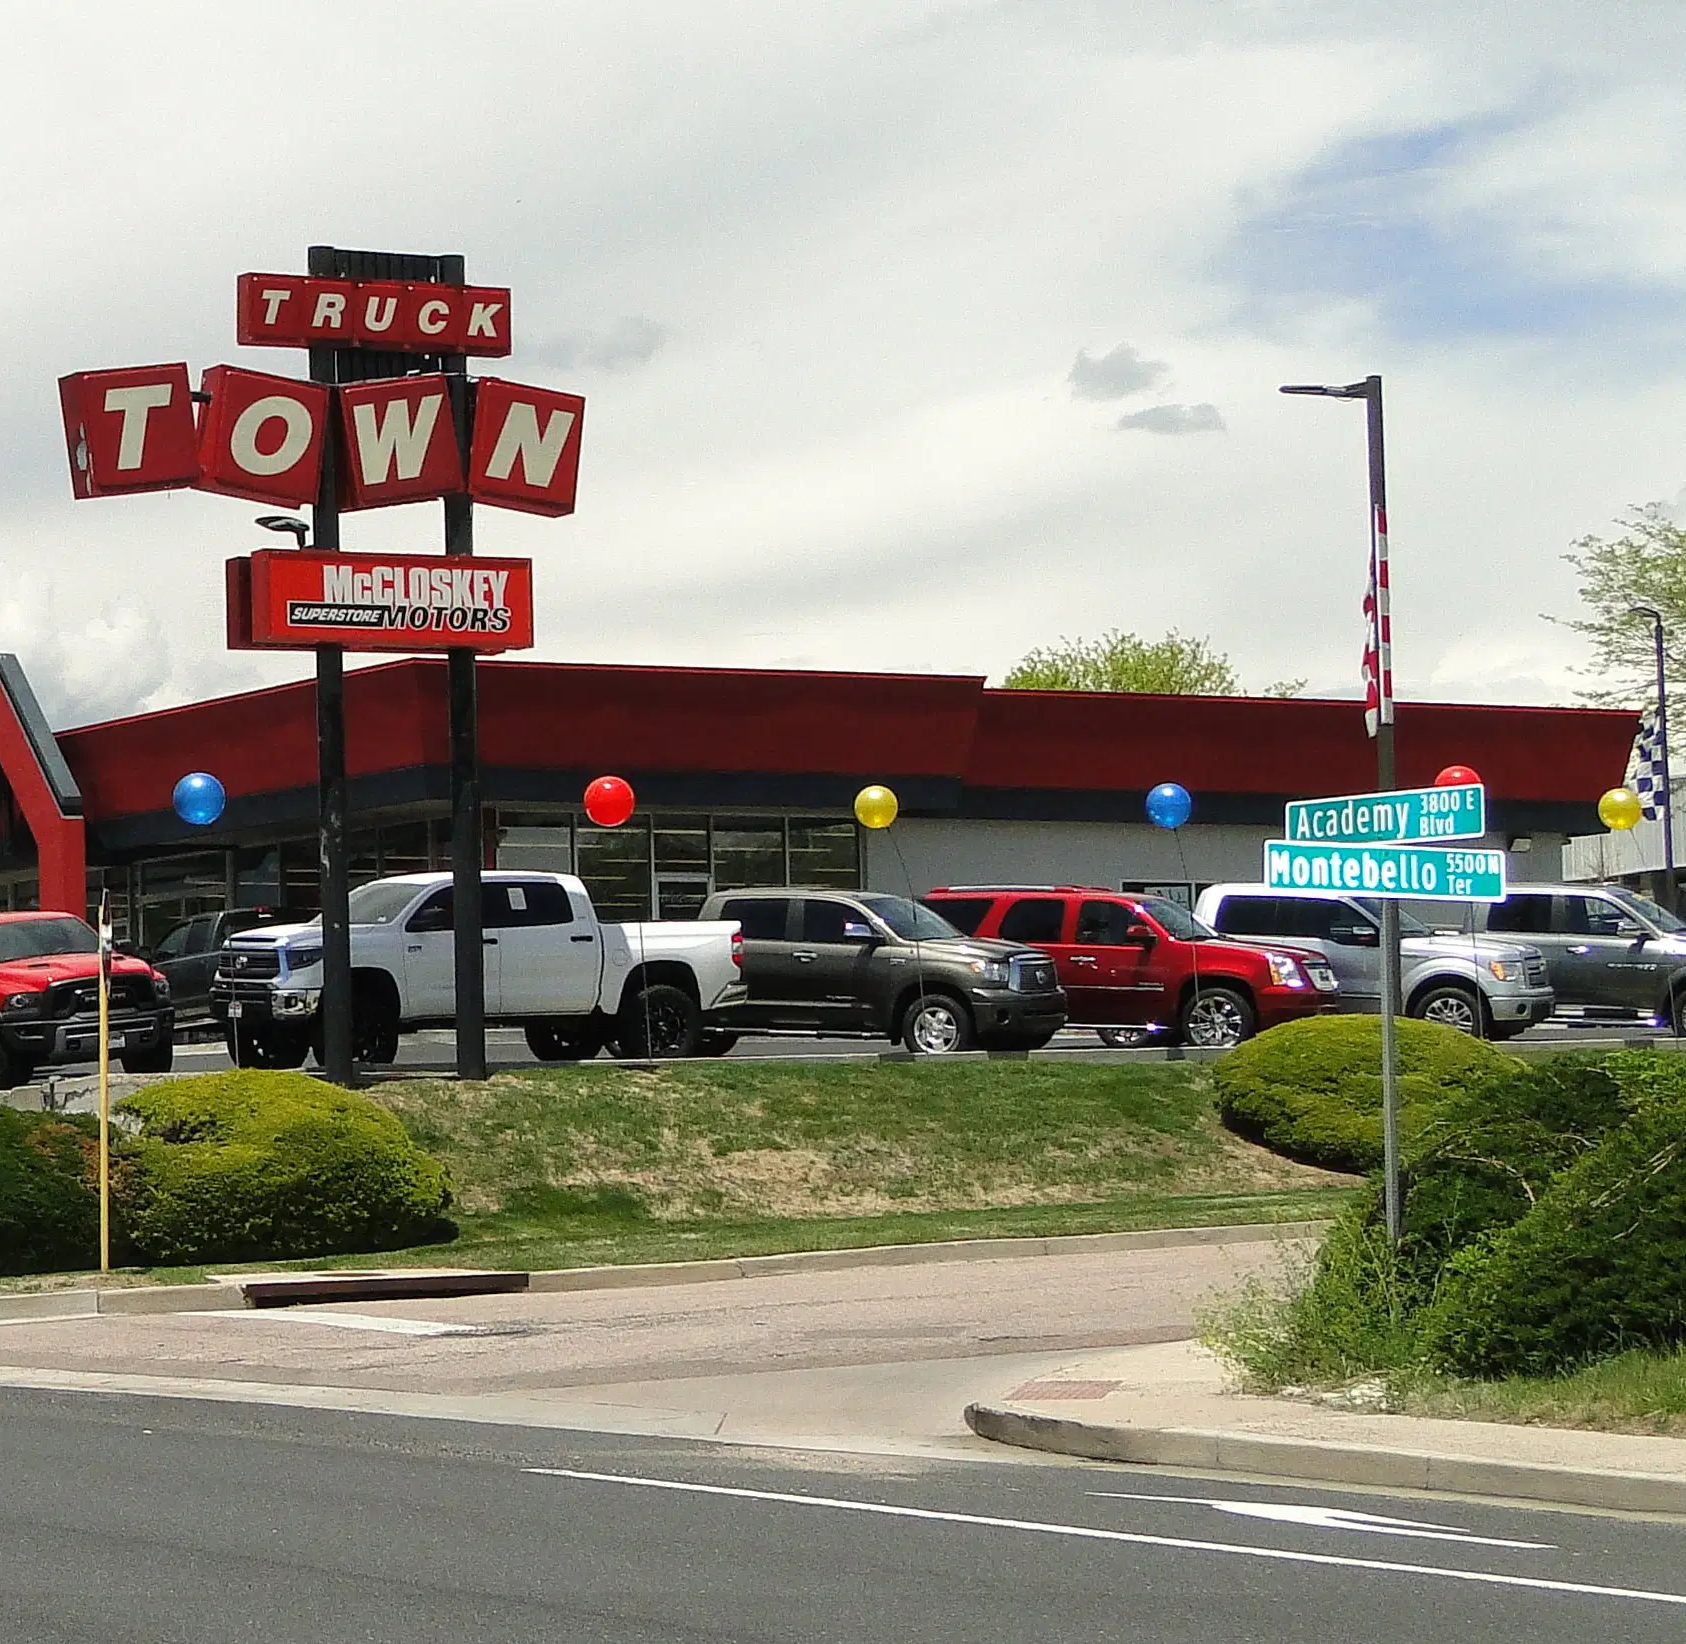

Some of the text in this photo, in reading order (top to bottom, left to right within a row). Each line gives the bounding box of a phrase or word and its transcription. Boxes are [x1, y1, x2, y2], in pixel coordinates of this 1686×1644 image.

[260, 289, 503, 338] TRUCK
[103, 382, 575, 489] TOWN
[323, 565, 509, 608] McCLOSKEY
[291, 605, 512, 632] SUPERSTORE MOTORS
[1419, 790, 1474, 814] 3800 E
[1295, 799, 1410, 839] Academy
[1419, 813, 1454, 836] Blvd
[1270, 850, 1437, 891] Montebello
[1446, 853, 1486, 874] 5500
[1447, 877, 1473, 895] Ter
